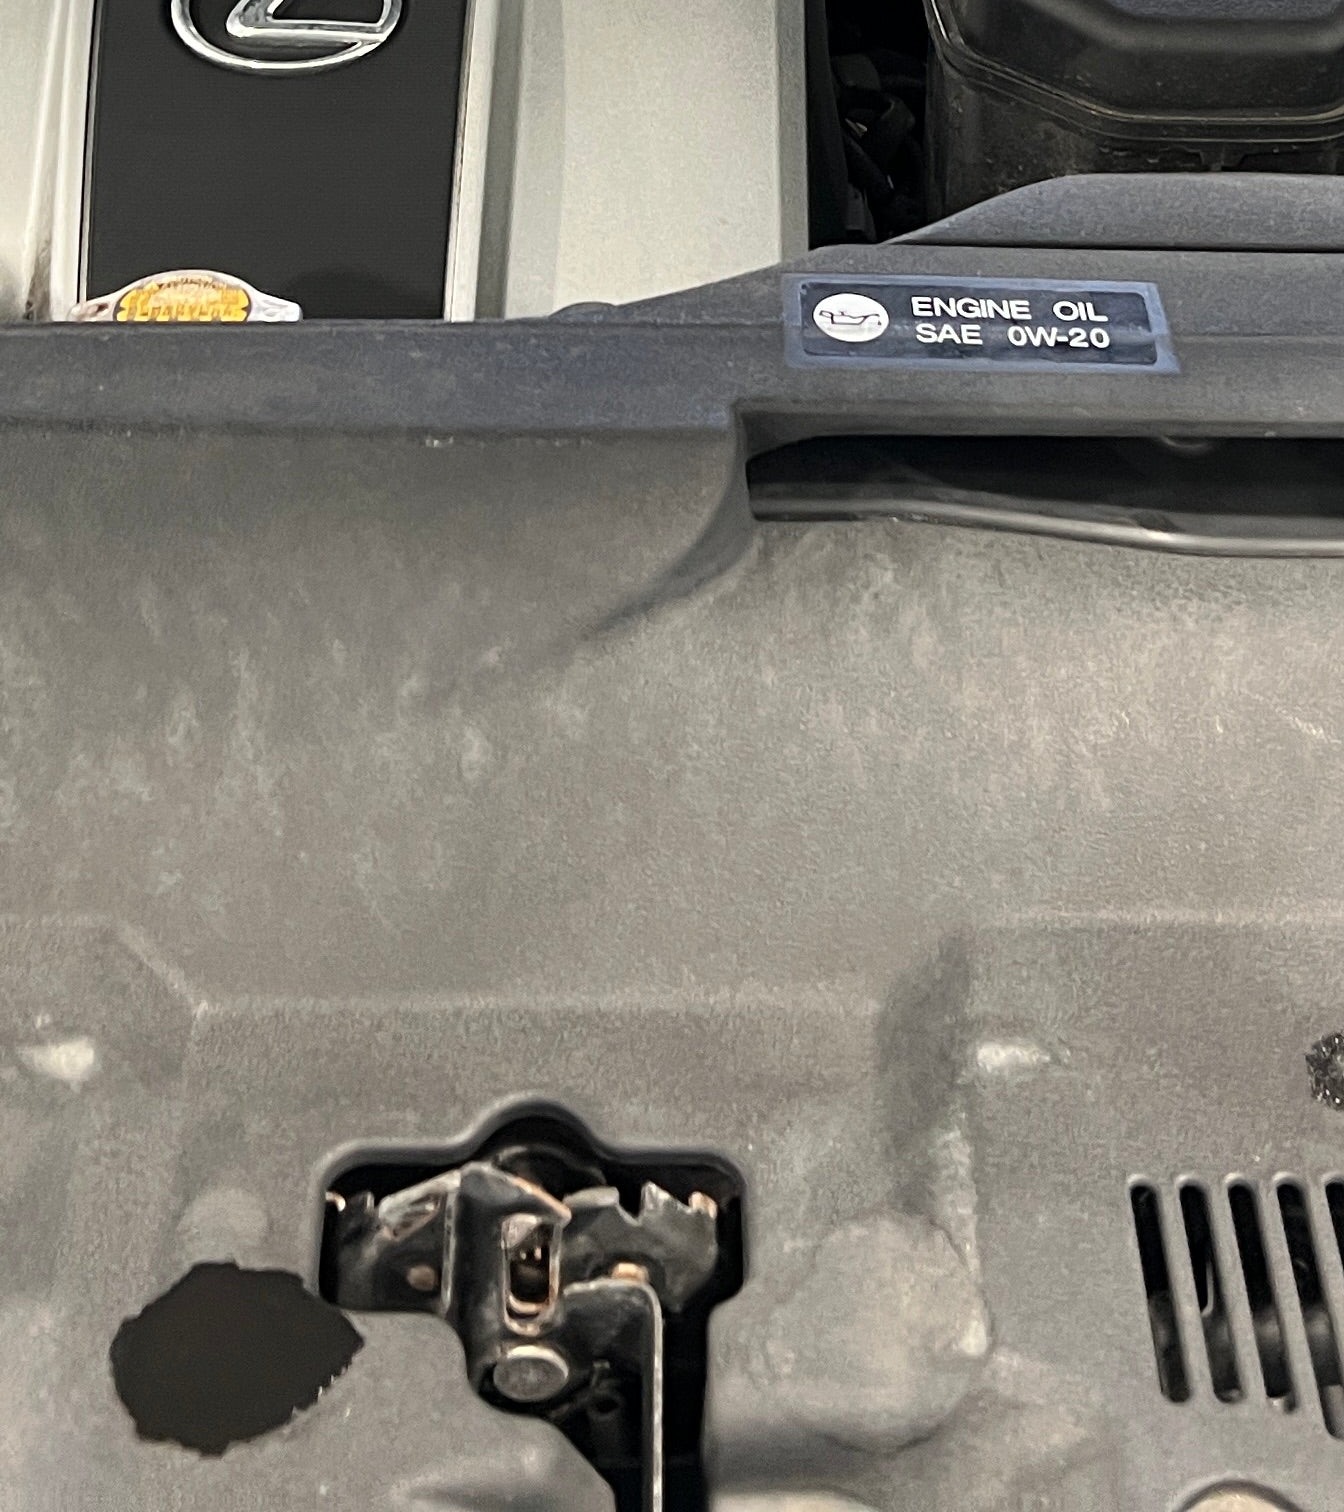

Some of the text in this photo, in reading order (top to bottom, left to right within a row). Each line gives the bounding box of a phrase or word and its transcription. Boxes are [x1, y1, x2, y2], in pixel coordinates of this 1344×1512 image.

[910, 295, 1109, 322] ENGINE OIL
[914, 322, 1111, 349] SAE 0W-20
